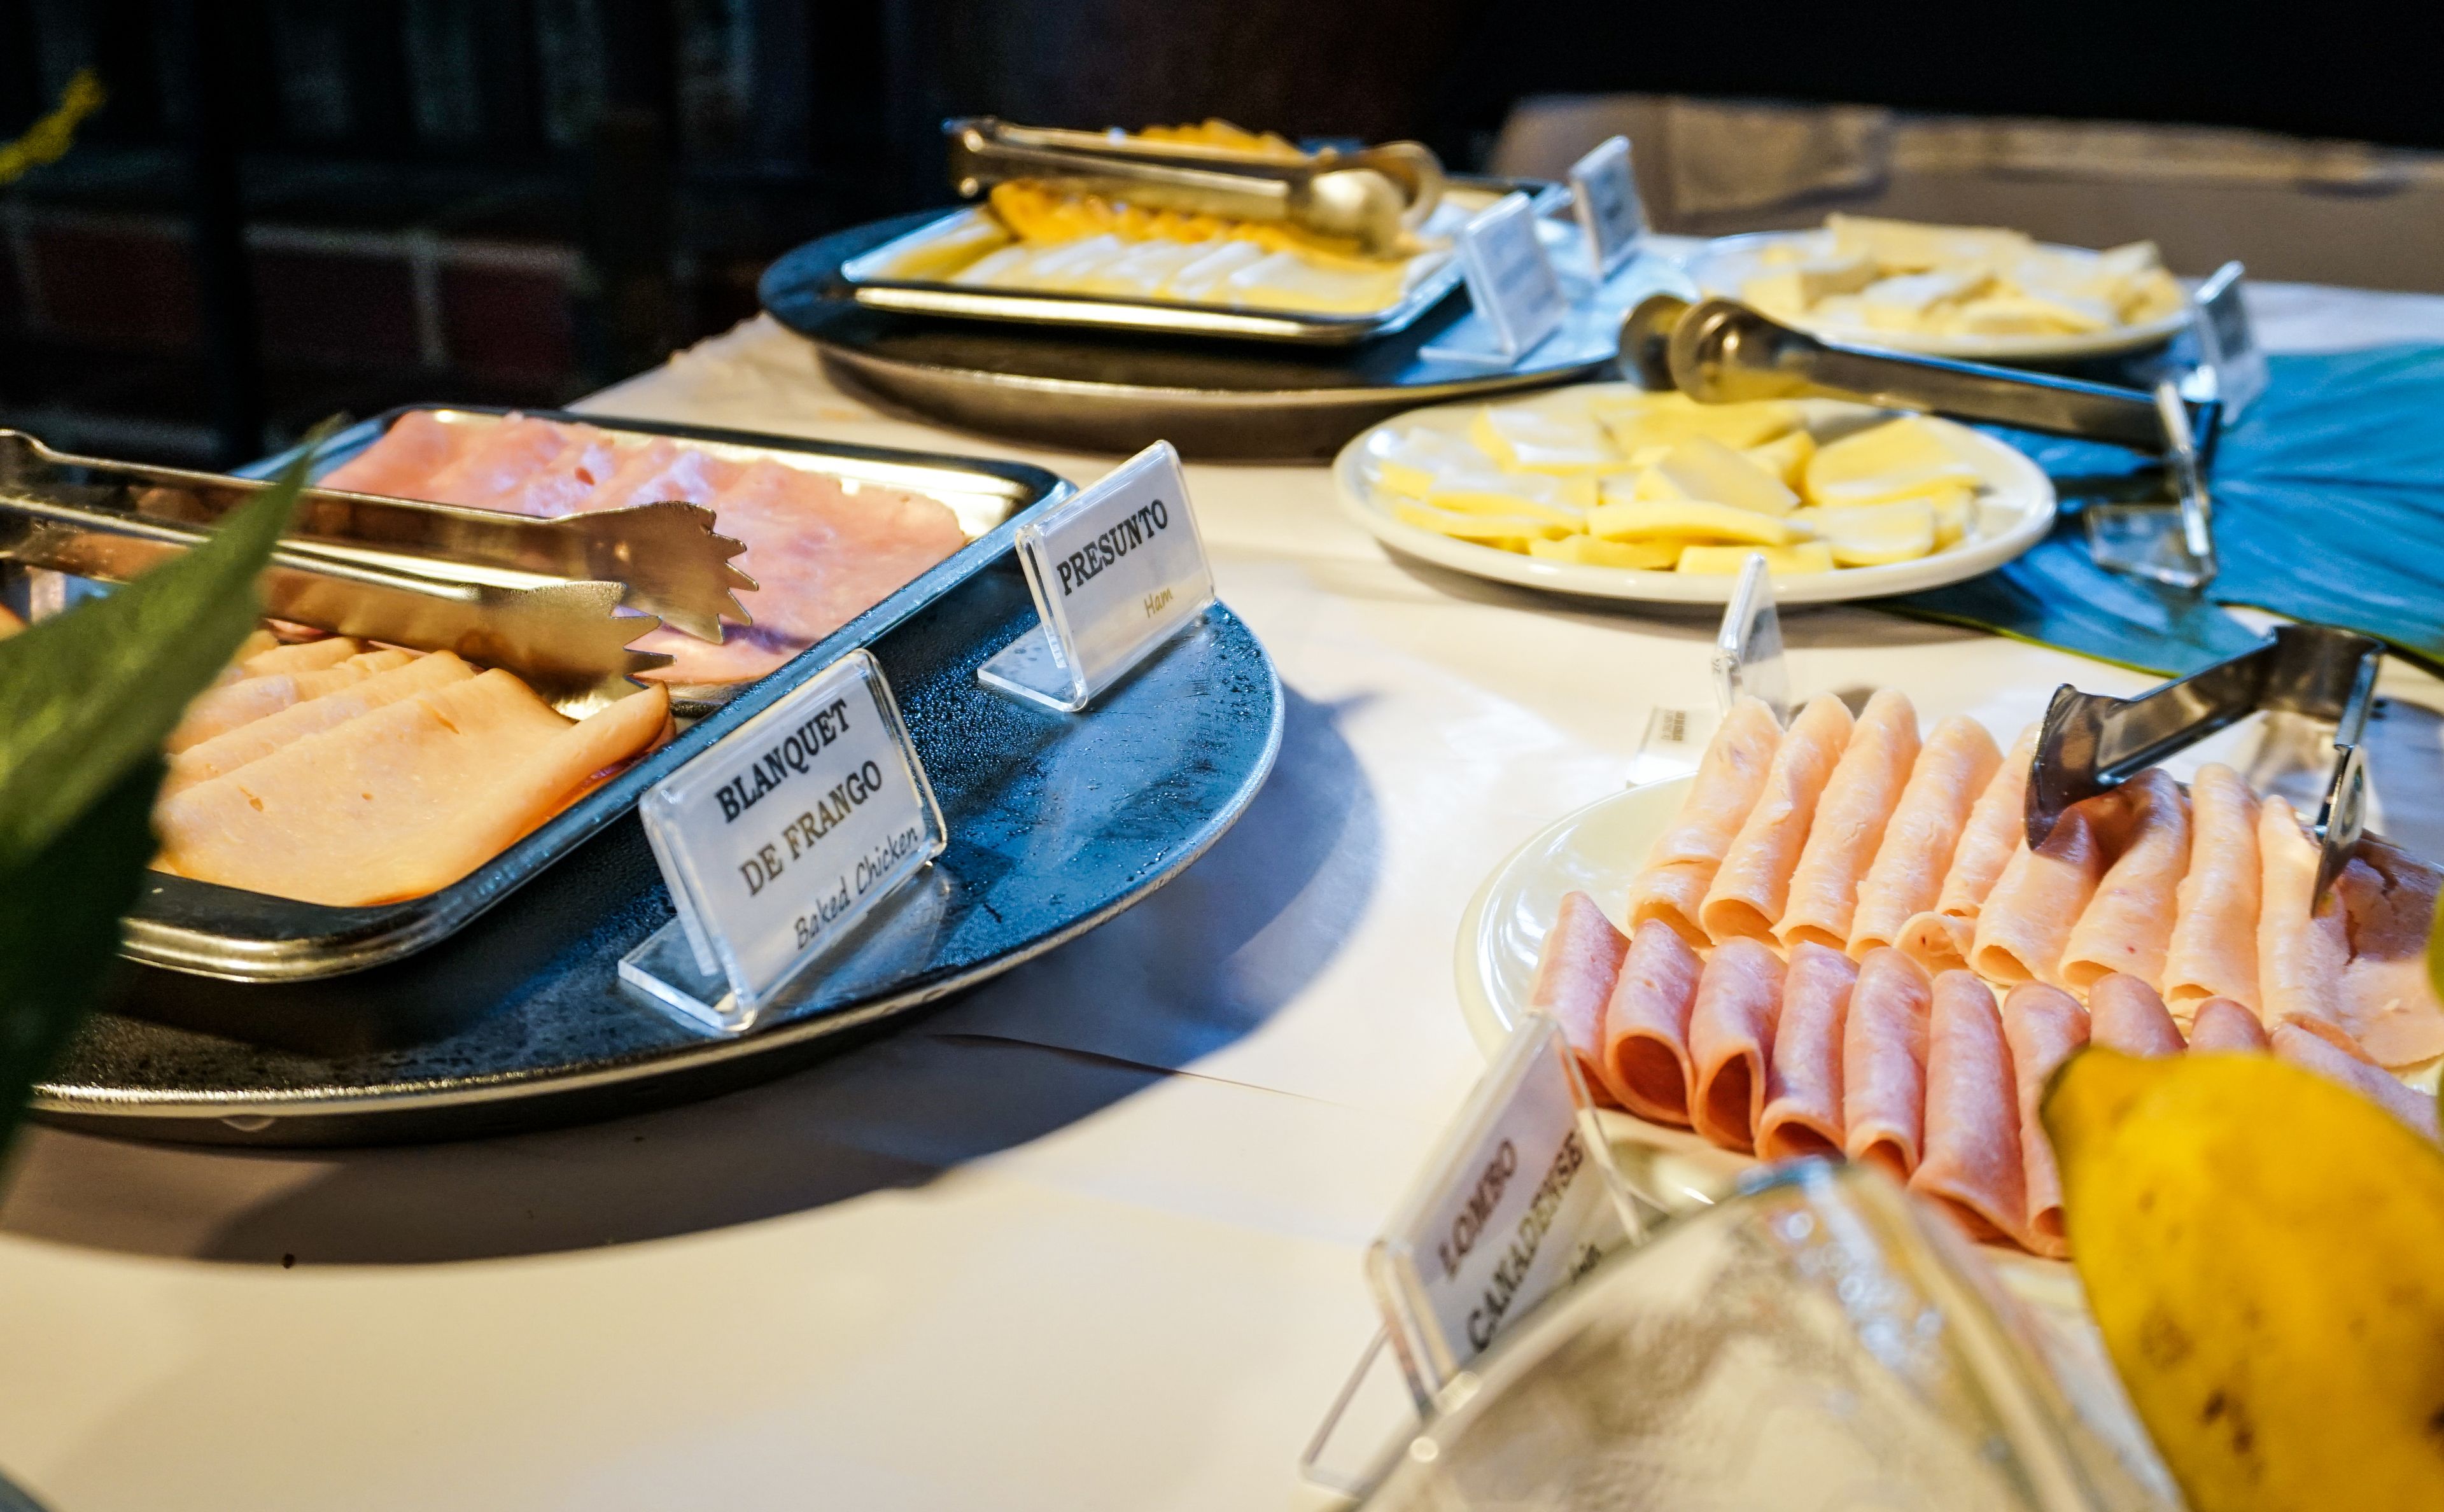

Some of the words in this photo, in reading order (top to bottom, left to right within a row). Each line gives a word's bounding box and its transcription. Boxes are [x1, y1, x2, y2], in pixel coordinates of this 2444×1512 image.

[1056, 499, 1168, 596] PRESUNTO
[1144, 587, 1173, 618] Ham
[715, 699, 849, 823] BLANQUET
[738, 845, 783, 898] DE
[782, 760, 883, 859] FRANGO
[793, 876, 850, 950] Baked
[855, 827, 918, 895] Chicken
[1438, 1138, 1517, 1279] LOMBO
[1466, 1131, 1584, 1354] CANADENSE
